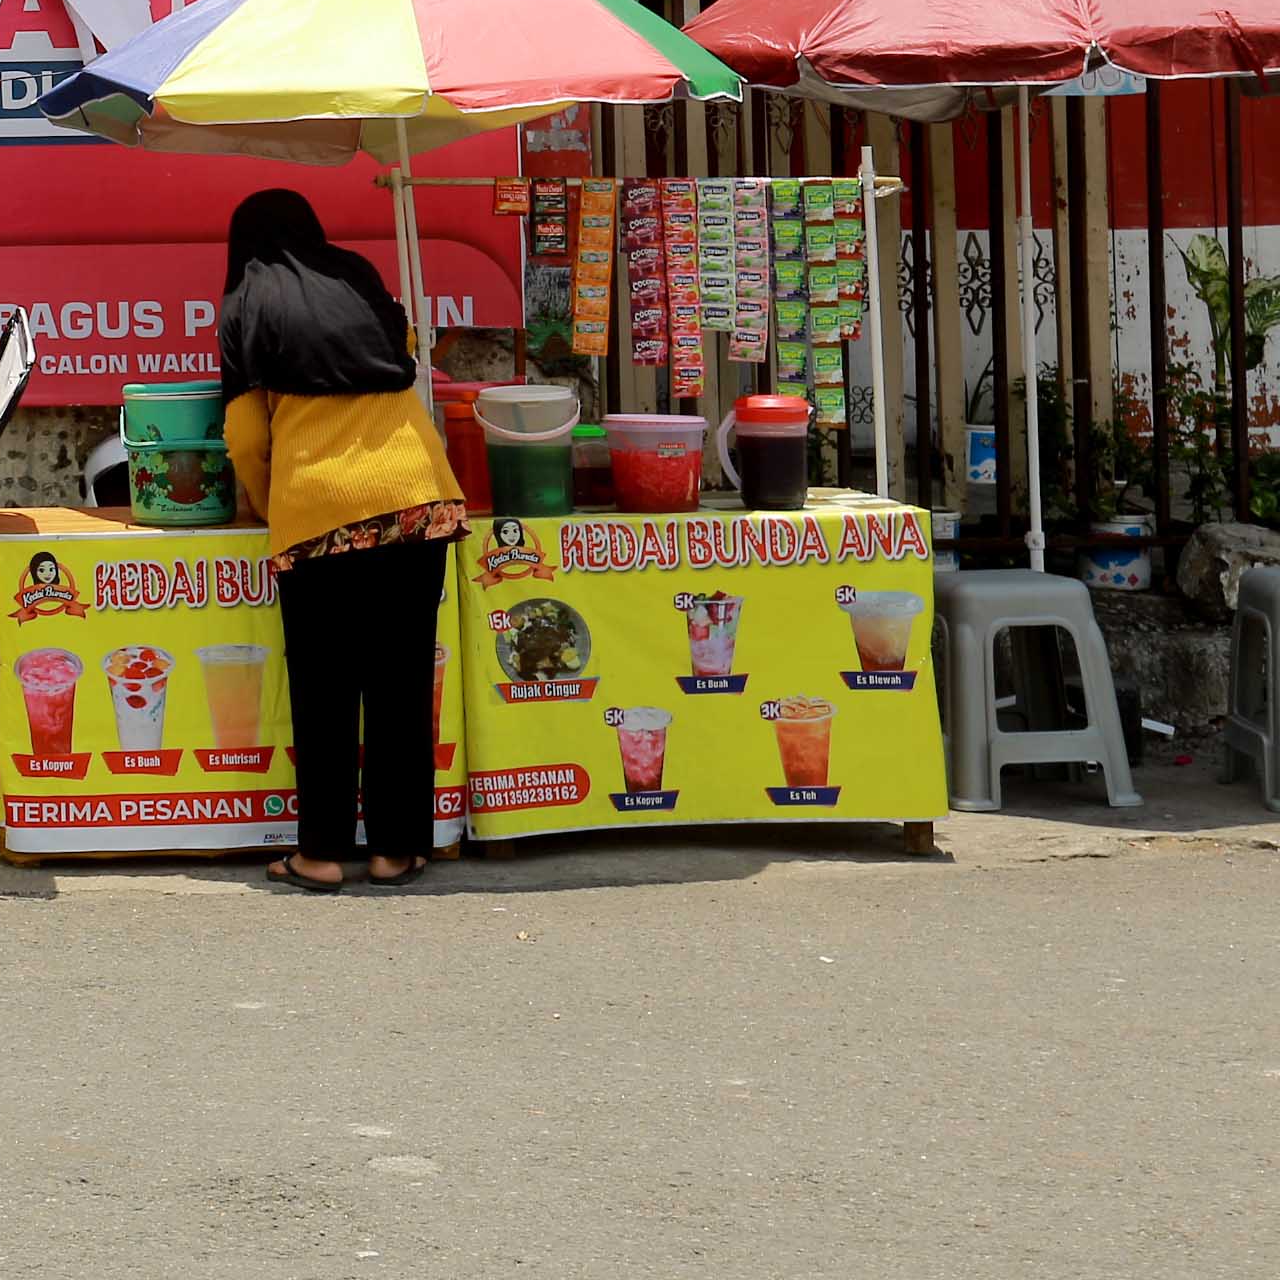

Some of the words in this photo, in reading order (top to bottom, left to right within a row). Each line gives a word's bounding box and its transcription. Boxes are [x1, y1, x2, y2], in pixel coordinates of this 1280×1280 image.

[40, 353, 129, 375] CALON
[138, 351, 221, 374] WAKIL
[559, 519, 680, 572] KEDAI
[685, 515, 829, 569] BUNDA
[837, 511, 929, 562] ANA
[487, 553, 510, 571] Kedai
[510, 549, 540, 565] Bunda
[94, 557, 208, 611] KEDAI
[23, 589, 44, 608] Kedai
[45, 584, 73, 602] Bunda
[674, 595, 695, 609] 5K
[837, 587, 856, 602] 5K
[696, 679, 706, 689] Es
[857, 675, 868, 685] Es
[869, 674, 902, 685] Blewah
[511, 682, 542, 700] Rujak
[545, 683, 581, 698] Cingur
[605, 710, 625, 725] 5K
[761, 703, 781, 718] 3K
[30, 759, 41, 771] Es
[42, 758, 74, 773] Kopyor
[125, 756, 137, 768] Es
[137, 755, 161, 767] Buah
[209, 754, 221, 766] Es
[469, 774, 515, 792] TERIMA
[518, 769, 576, 787] PESANAN
[486, 786, 579, 808] 081359238162
[624, 796, 635, 807] Es
[790, 791, 801, 801] Es
[802, 791, 817, 801] Teh
[8, 800, 113, 823] TERIMA
[120, 797, 253, 822] PESANAN
